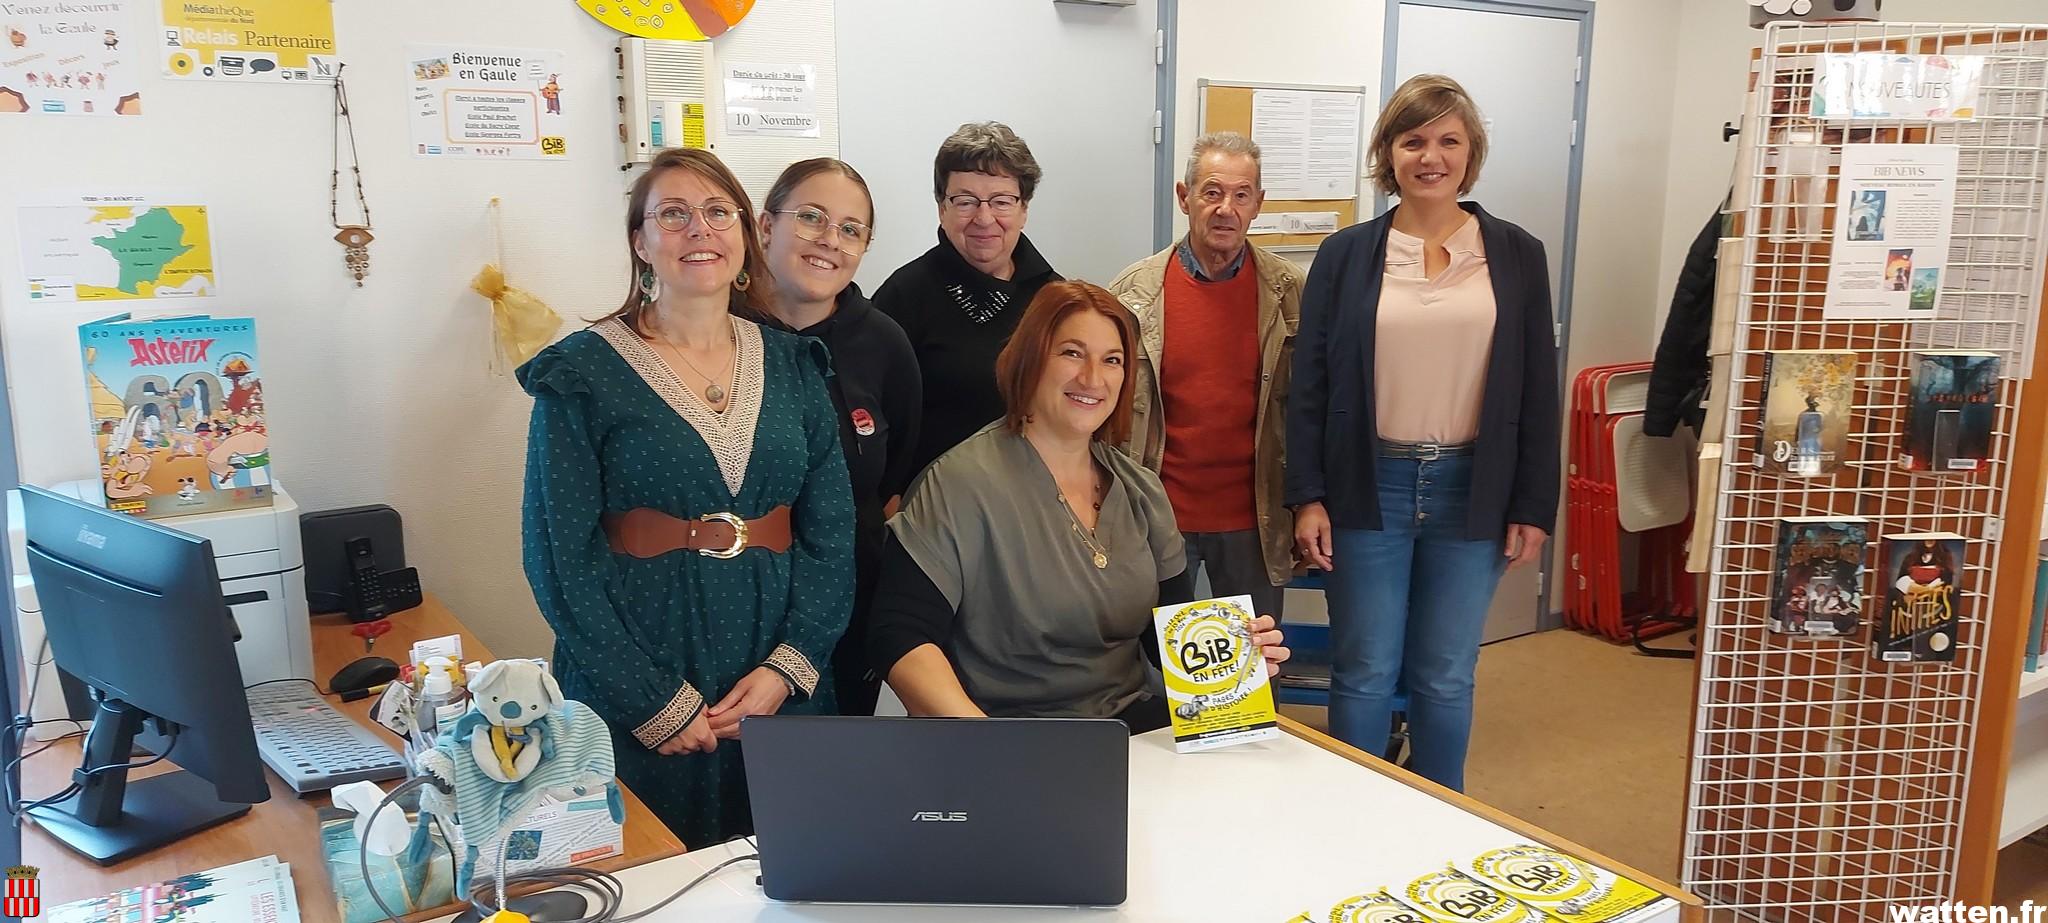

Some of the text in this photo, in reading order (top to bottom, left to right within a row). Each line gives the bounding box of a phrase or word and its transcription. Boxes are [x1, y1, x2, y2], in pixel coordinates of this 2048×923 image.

[1, 3, 49, 15] Venez
[56, 21, 97, 34] Gaule
[182, 27, 331, 49] Relais Partenaire
[452, 52, 522, 67] Bienvenue
[459, 69, 475, 80] en
[479, 68, 517, 81] Gaule
[736, 113, 812, 126] 10 Novembre
[1894, 166, 1926, 177] NEWS
[119, 329, 145, 337] ANS
[154, 325, 249, 335] D'AVENTURES
[1181, 637, 1234, 675] BiB
[1193, 671, 1209, 683] EN
[911, 811, 968, 821] ASUS
[1506, 864, 1563, 892] BiB
[1440, 889, 1501, 920] BiB
